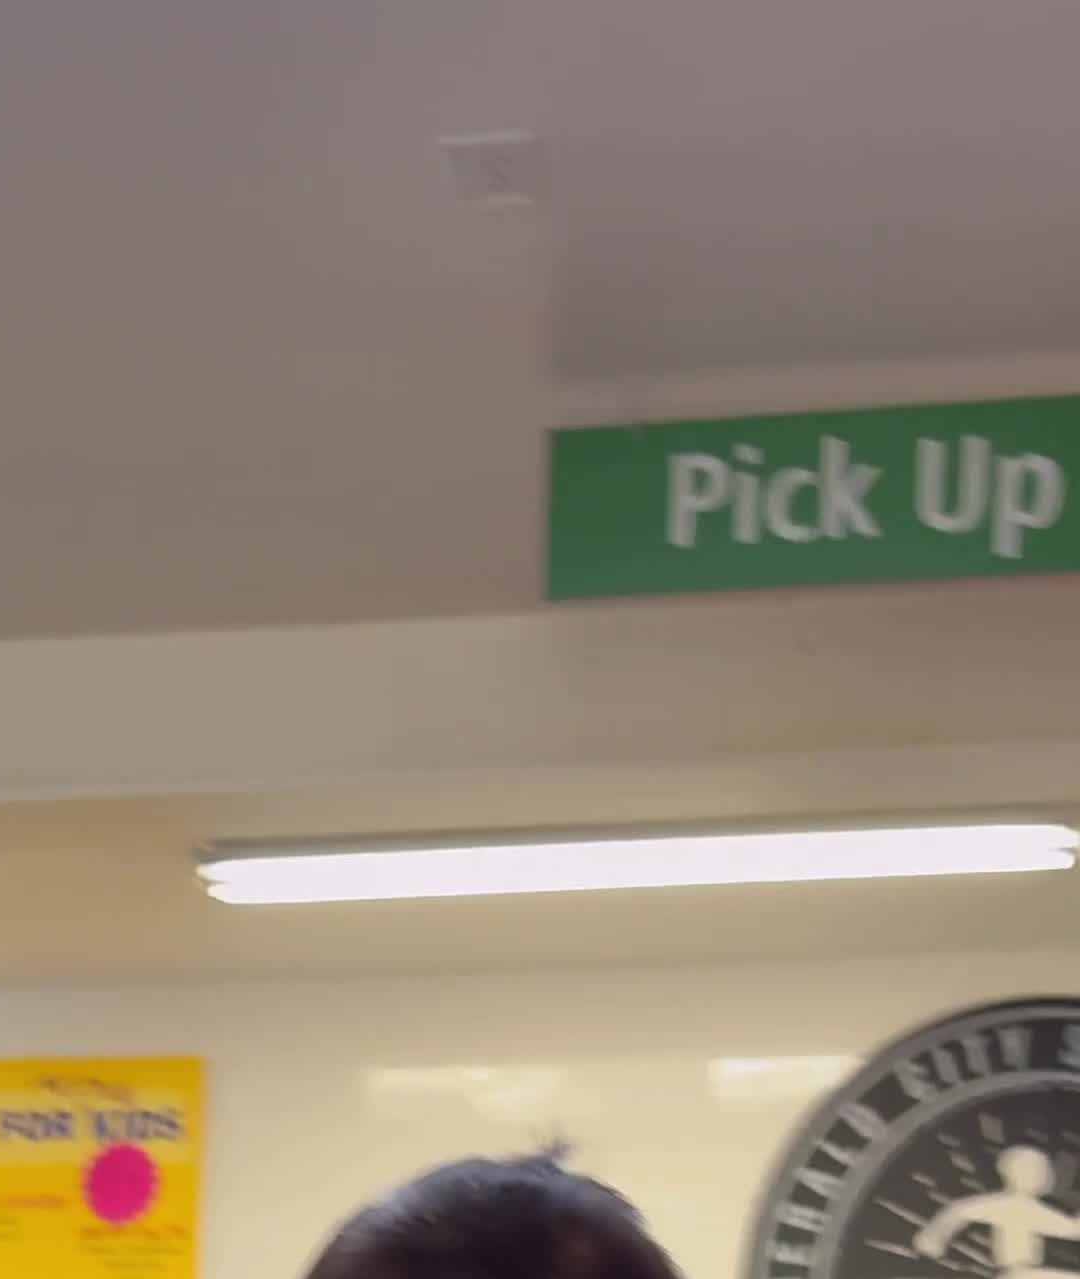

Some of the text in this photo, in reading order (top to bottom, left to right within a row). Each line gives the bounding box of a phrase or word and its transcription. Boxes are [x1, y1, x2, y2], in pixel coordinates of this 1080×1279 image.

[666, 435, 1065, 559] Pick Up
[892, 1026, 1032, 1101] CITY
[92, 1107, 186, 1140] KIDS
